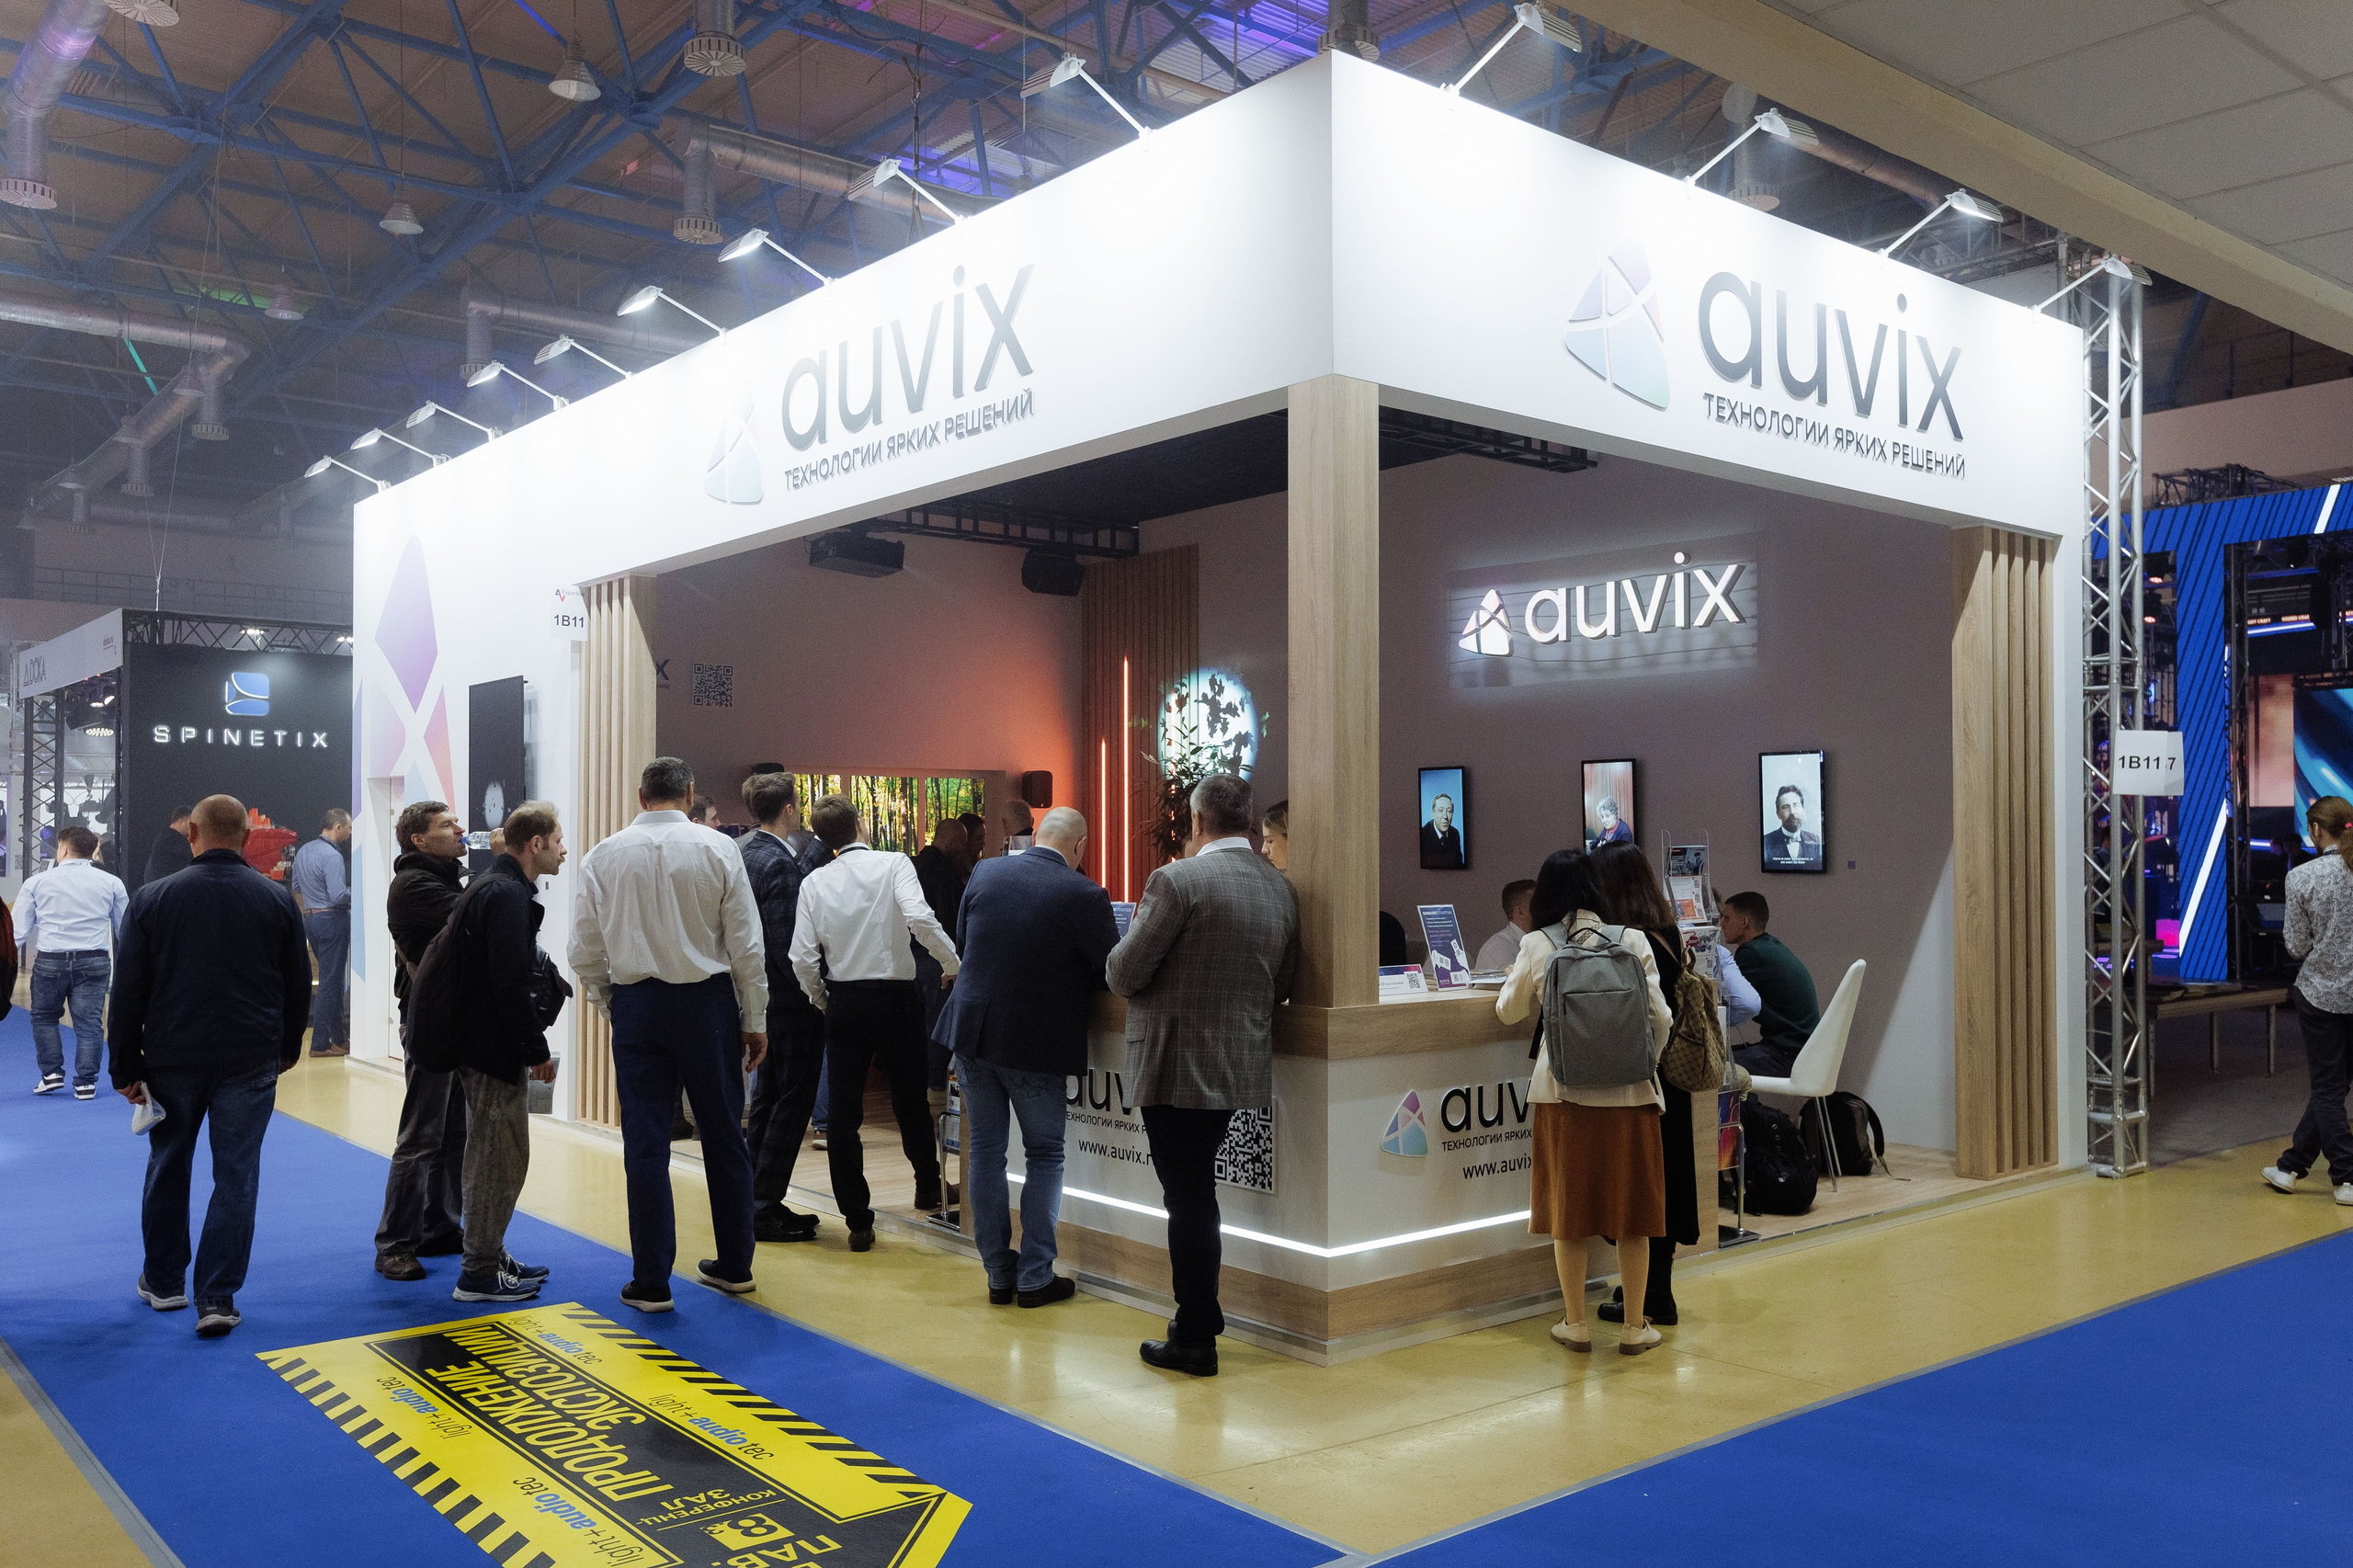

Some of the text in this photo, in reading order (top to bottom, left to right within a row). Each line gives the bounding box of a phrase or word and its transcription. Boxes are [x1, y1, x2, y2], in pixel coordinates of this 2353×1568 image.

[781, 264, 1035, 451] auvix
[1698, 271, 1964, 441] auvix
[784, 387, 1035, 490] ТЕХНОЛОГИИ ЯРКИХ РЕШЕНИЙ
[1702, 392, 1966, 478] ТЕХНОЛОГИИ ЯРКИХ РЕШЕНИЙ
[1524, 551, 1745, 644] auvix
[554, 614, 584, 628] 1B11
[153, 725, 327, 747] SPINETIX
[1066, 1068, 1132, 1116] auv
[1440, 1079, 1532, 1133] auv
[1066, 1111, 1113, 1129] ЕХНОЛОГИИ
[1114, 1119, 1141, 1134] ЯРКИХ
[1078, 1140, 1153, 1166] www.auvix.r
[1442, 1129, 1532, 1152] ТЕХНОЛОГИИ ЯРКИХ
[537, 1333, 583, 1354] audio
[573, 1351, 602, 1365] tec
[376, 1376, 405, 1391] tec
[442, 1325, 646, 1430] ЭКСПОЗИЦИИ
[390, 1388, 439, 1414] audio
[424, 1360, 674, 1502] ПРОДОЛЖЕНИЕ
[426, 1418, 472, 1439] light
[648, 1393, 693, 1414] light
[688, 1416, 748, 1446] audio
[737, 1442, 774, 1460] tec
[512, 1477, 549, 1495] tec
[660, 1489, 731, 1511] ЗАЛ
[533, 1493, 597, 1529] audio
[588, 1535, 644, 1567] light
